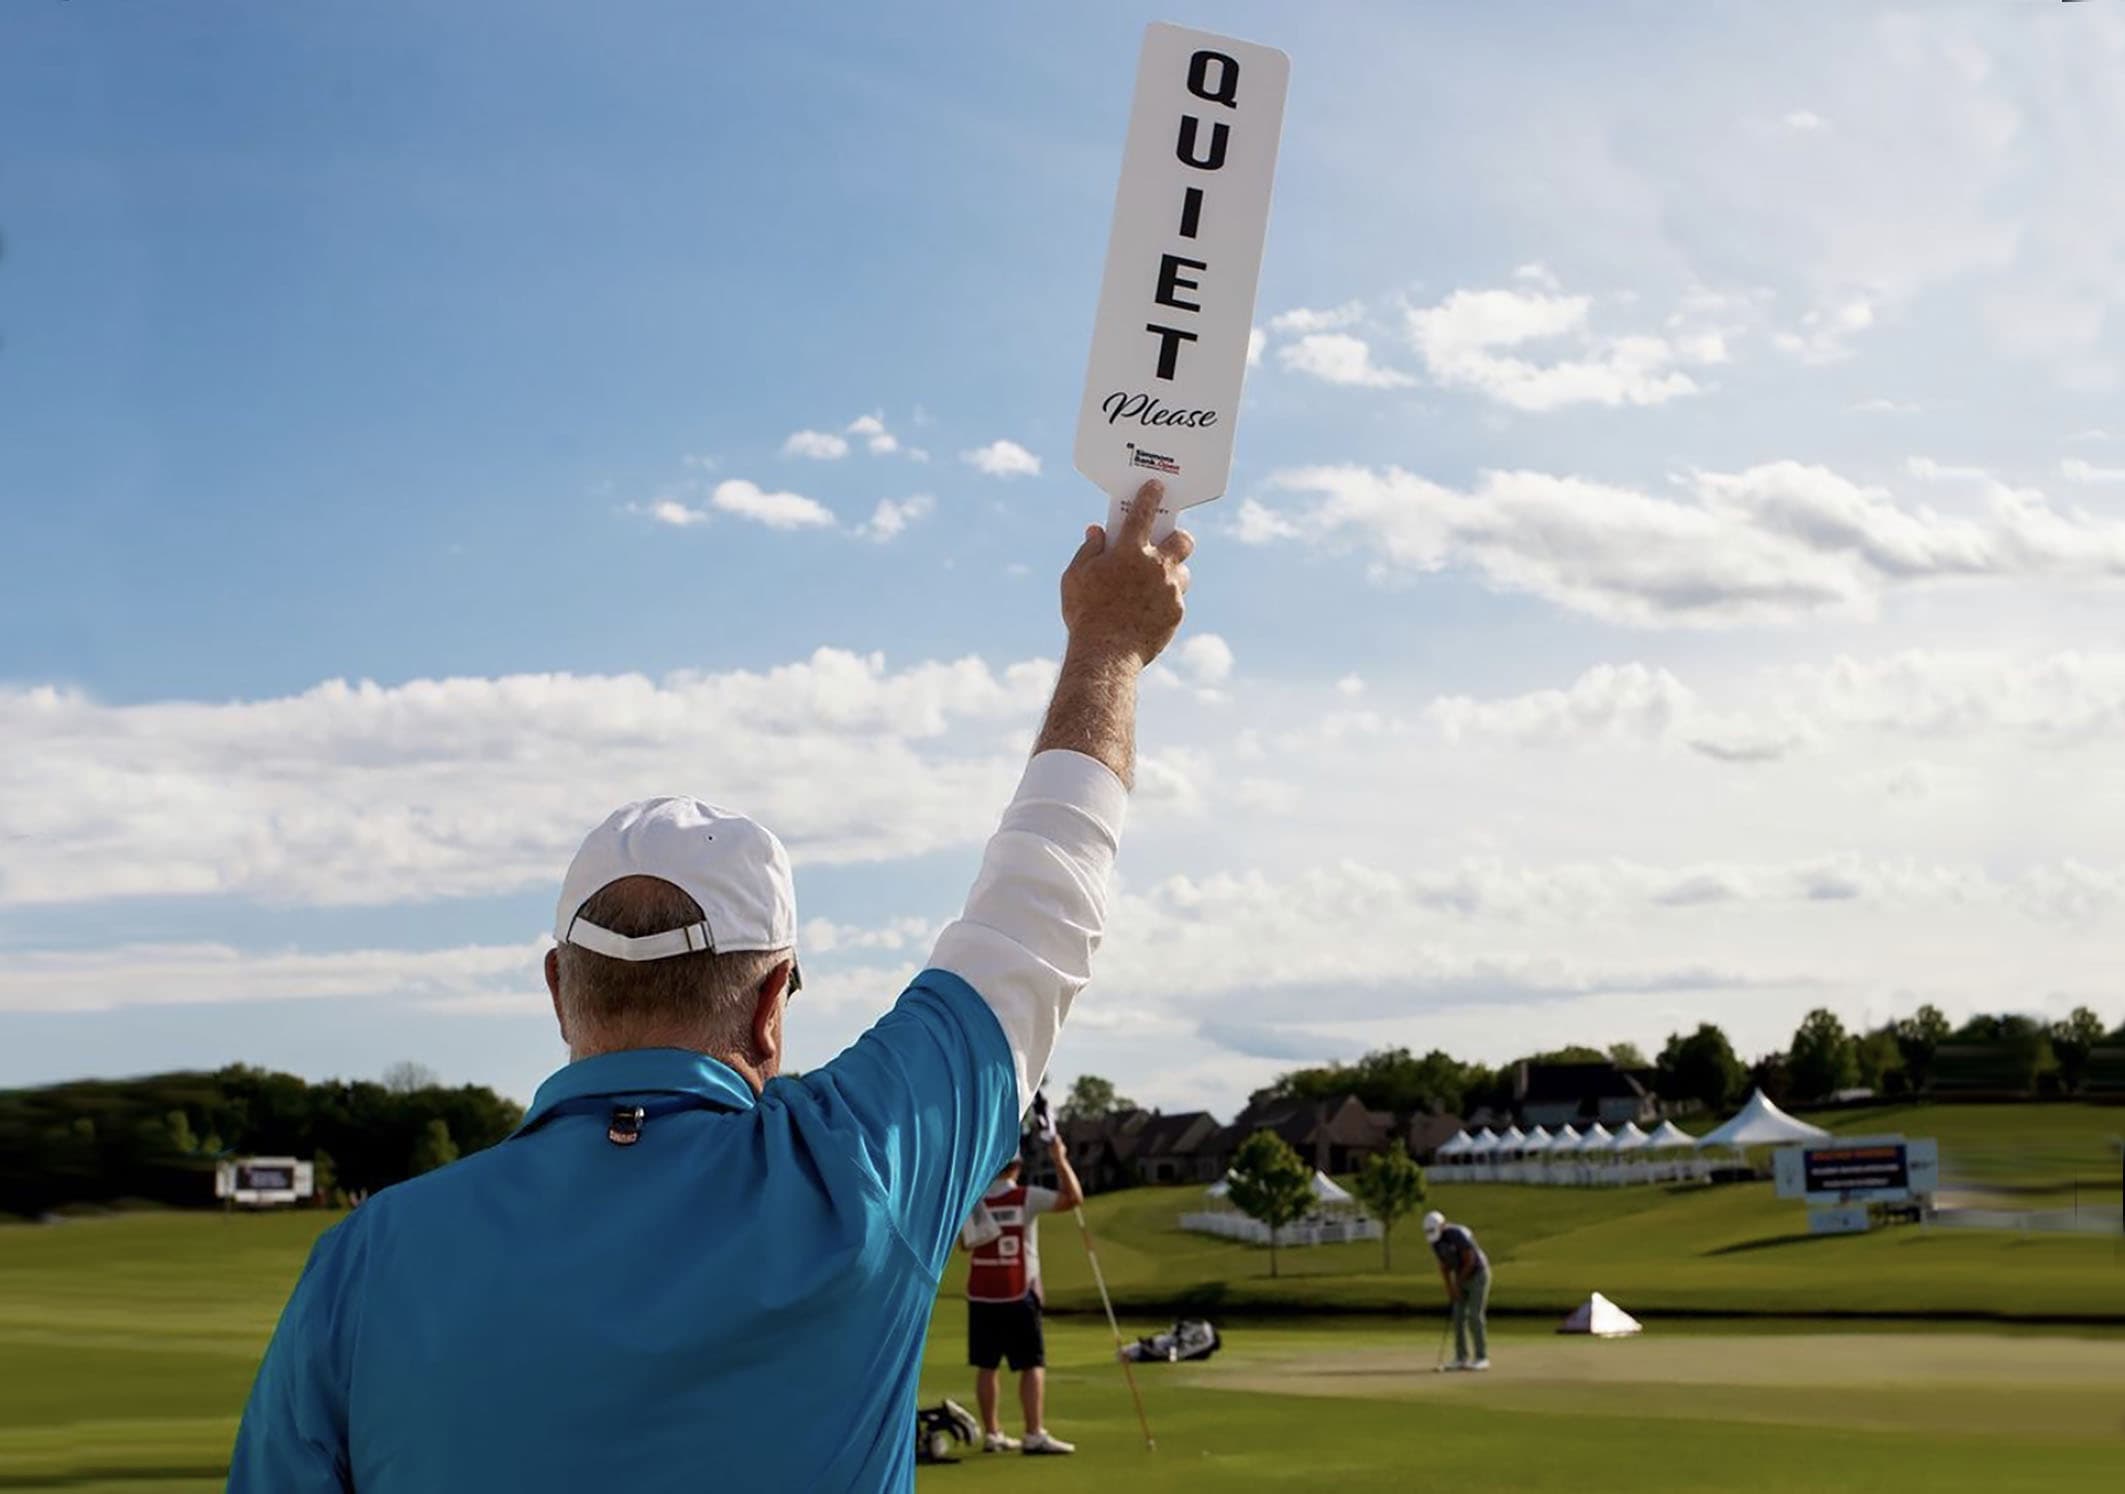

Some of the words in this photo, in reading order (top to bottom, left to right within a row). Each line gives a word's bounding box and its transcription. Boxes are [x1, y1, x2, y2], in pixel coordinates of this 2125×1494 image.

[1146, 50, 1240, 381] QUIET
[1102, 391, 1218, 428] Please
[1136, 449, 1175, 464] Simmons
